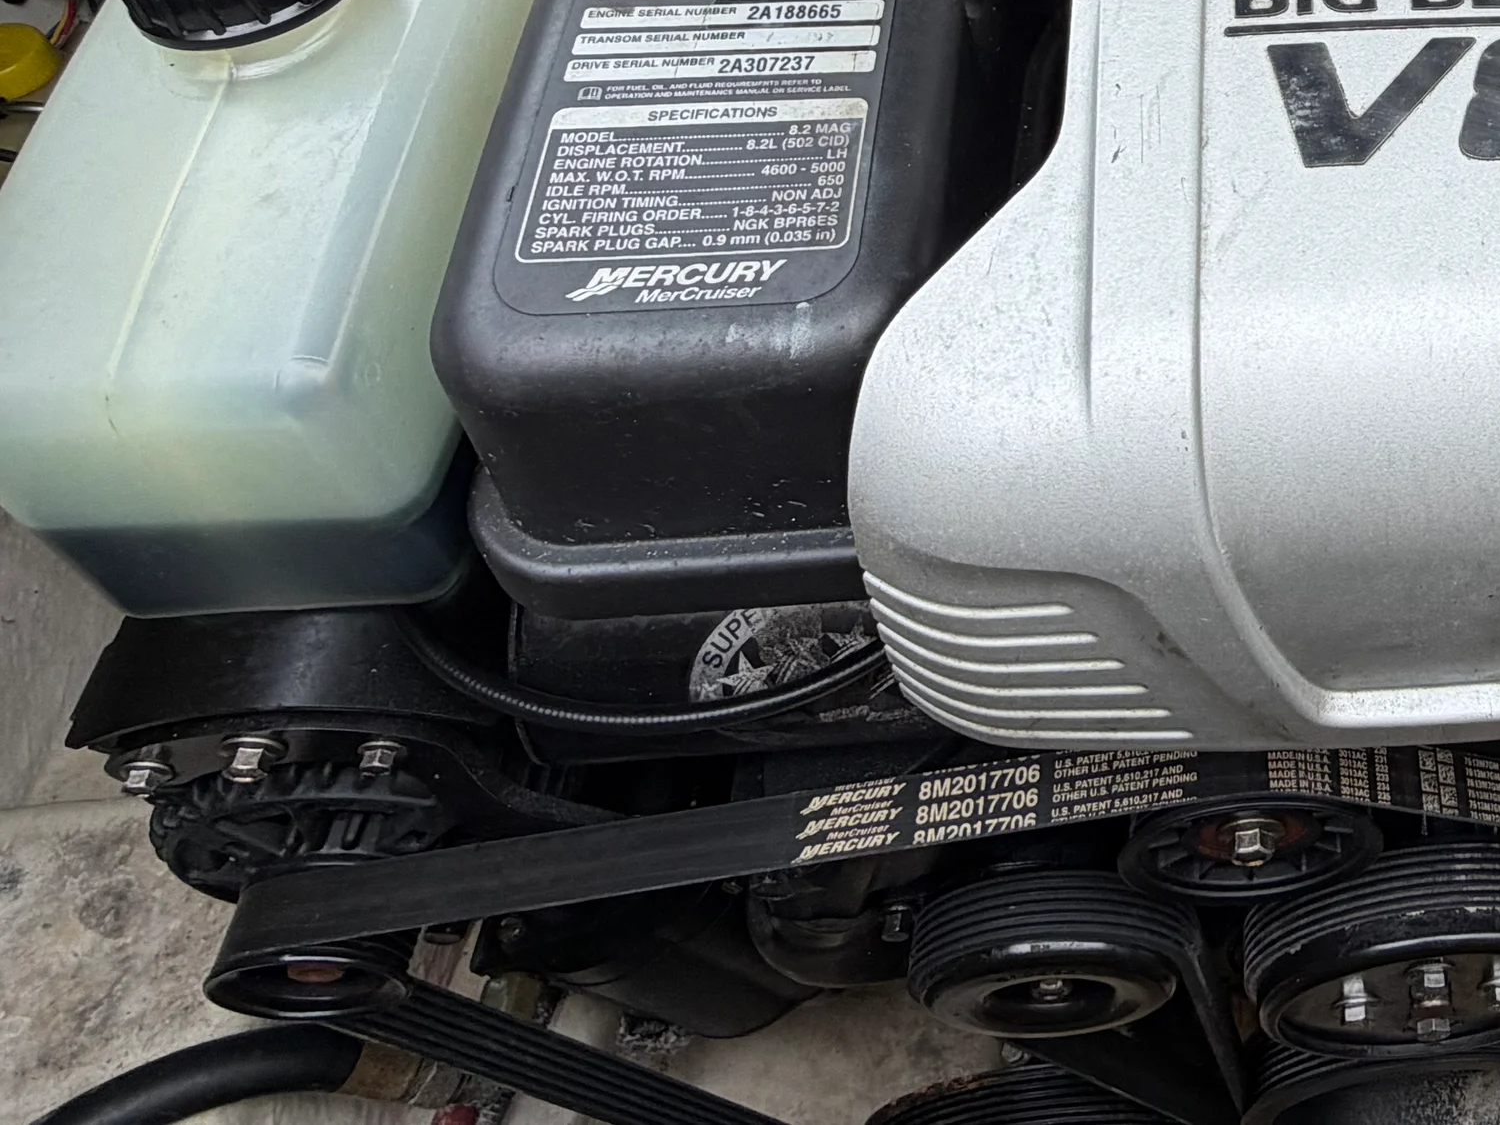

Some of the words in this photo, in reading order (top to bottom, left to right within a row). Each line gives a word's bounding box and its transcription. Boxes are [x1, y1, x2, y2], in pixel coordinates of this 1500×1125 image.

[588, 10, 635, 18] ENGINE
[638, 8, 682, 17] SERIAL
[685, 6, 737, 16] NUMBER
[747, 4, 842, 20] 2A188665
[580, 35, 642, 44] TRANSOM
[645, 33, 689, 43] SERIAL
[692, 31, 745, 41] NUMBER
[571, 61, 610, 70] DRIVE
[613, 59, 660, 69] SERIAL
[662, 57, 715, 67] NUMBER
[718, 56, 815, 74] 2A307237
[604, 92, 653, 100] OPERATION
[674, 89, 733, 97] MAINTENANCE
[735, 87, 769, 95] MANUAL
[715, 80, 779, 88] REQUIREMENTS
[648, 107, 777, 122] SPECIFICATIONS
[788, 125, 811, 135] 8.2
[815, 123, 851, 134] MAG
[746, 139, 778, 150] 8.2L
[782, 137, 813, 150] (502
[817, 135, 850, 148] CID)
[553, 158, 617, 170] ENGINE
[826, 148, 847, 159] LH
[549, 172, 590, 184] MAX.
[596, 170, 643, 182] W.O.T.
[761, 164, 797, 175] 4600
[810, 162, 846, 173] 5000
[546, 185, 584, 197] IDLE
[817, 175, 844, 186] 650
[542, 197, 617, 211] IGNITION
[771, 189, 807, 202] NON
[810, 188, 842, 200] ADJ
[538, 213, 576, 225] CYL.
[581, 211, 638, 223] FIRING
[732, 202, 840, 218] 1-8-4-3-6-5-7-2
[534, 226, 593, 239] SPARK
[733, 218, 770, 231] NGK
[773, 215, 838, 228] BPR6ES
[530, 240, 590, 253] SPARK
[593, 238, 640, 251] PLUG
[702, 234, 727, 246] 0.9
[730, 234, 760, 245] mm
[764, 229, 811, 245] (0.035
[815, 228, 837, 243] in)
[582, 259, 788, 290] MERCURY
[634, 286, 762, 304] MerCruiser
[1054, 766, 1088, 779] OTHER
[1091, 763, 1110, 774] U.S.
[1113, 756, 1151, 770] PATENT
[1153, 751, 1198, 764] PENDING
[1055, 759, 1074, 769] U.S.
[1076, 752, 1114, 767] PATENT
[1268, 752, 1295, 760] MADE
[918, 764, 1041, 801] 8M2017706
[1052, 790, 1087, 803] OTHER
[1090, 787, 1109, 797] U.S.
[1111, 780, 1150, 794] PATENT
[1152, 772, 1198, 787] PENDING
[1053, 784, 1072, 793] U.S.
[1075, 776, 1113, 790] PATENT
[1161, 764, 1183, 775] AND
[1269, 779, 1297, 788] MADE
[1299, 780, 1308, 788] IN
[803, 782, 907, 813] MERCURY
[830, 800, 893, 816] MerCruiser
[915, 788, 1040, 825] 8M2017706
[1051, 807, 1071, 818] U.S.
[1073, 800, 1111, 814] PATENT
[1160, 789, 1183, 800] AND
[798, 807, 903, 838] MERCURY
[826, 824, 889, 841] MerCruiser
[794, 831, 900, 862] MERCURY
